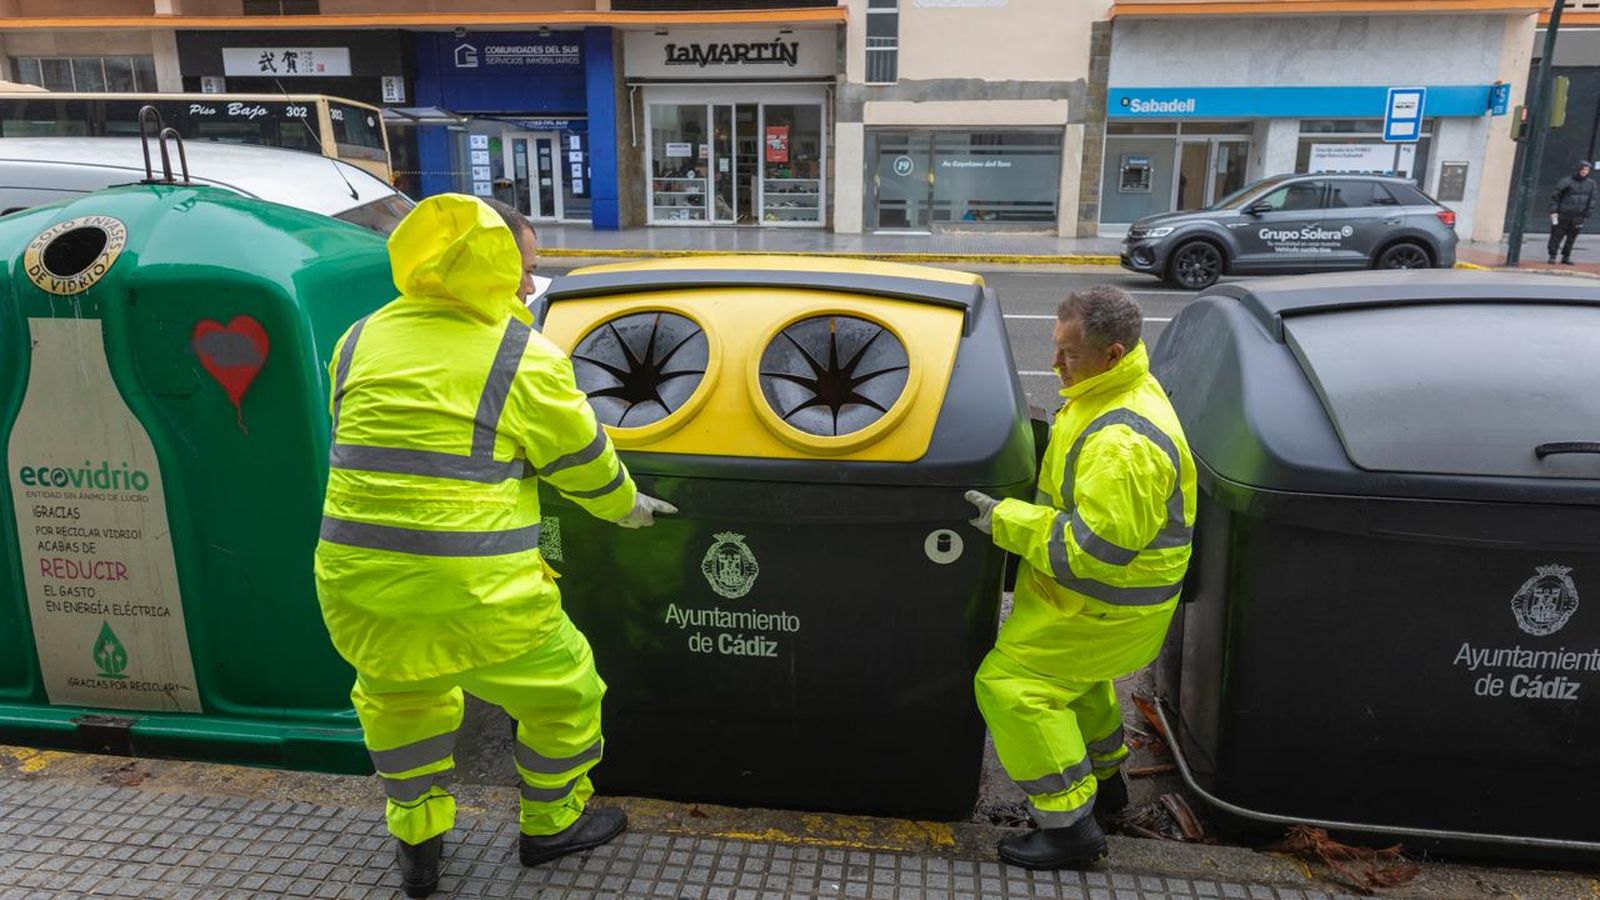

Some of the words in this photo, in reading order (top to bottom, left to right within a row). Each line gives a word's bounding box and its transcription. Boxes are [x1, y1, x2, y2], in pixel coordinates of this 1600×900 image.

[484, 46, 544, 55] COMUNIDADES
[545, 46, 561, 55] DEL
[562, 45, 580, 54] SUR
[664, 37, 799, 68] LaMARTÍN
[484, 56, 525, 66] SERVICIOS
[526, 56, 580, 65] INMOBILIARIOS
[189, 104, 216, 116] Piso
[227, 102, 269, 120] Bajo
[286, 106, 308, 118] 302
[1130, 97, 1196, 113] Sabadell
[898, 161, 910, 171] 19
[31, 220, 76, 250] SOLO
[83, 216, 125, 251] ENVASES
[1259, 228, 1300, 242] Grupo
[1300, 227, 1342, 240] Solera
[28, 264, 47, 285] DE
[50, 263, 106, 293] VIDRIO
[19, 460, 150, 492] ecovidrio
[25, 490, 63, 499] ENTIDAD
[63, 491, 78, 500] SIN
[107, 493, 119, 501] DE
[120, 493, 150, 503] LUCRO
[36, 525, 53, 536] POR
[56, 525, 100, 538] RECICLAR
[102, 528, 142, 540] VIDRIO!
[38, 540, 80, 553] ACABAS
[82, 541, 97, 554] DE
[40, 557, 129, 581] REDUCIR
[44, 584, 57, 597] EL
[59, 585, 96, 598] GASTO
[46, 600, 62, 613] EN
[64, 600, 110, 615] ENERGÍA
[113, 601, 171, 617] ELÉCTRICA
[664, 603, 801, 632] Ayuntamiento
[688, 632, 714, 654] de
[718, 633, 779, 657] Cádiz
[109, 678, 129, 690] POR
[1474, 673, 1505, 696] de
[1510, 674, 1581, 700] Cádiz
